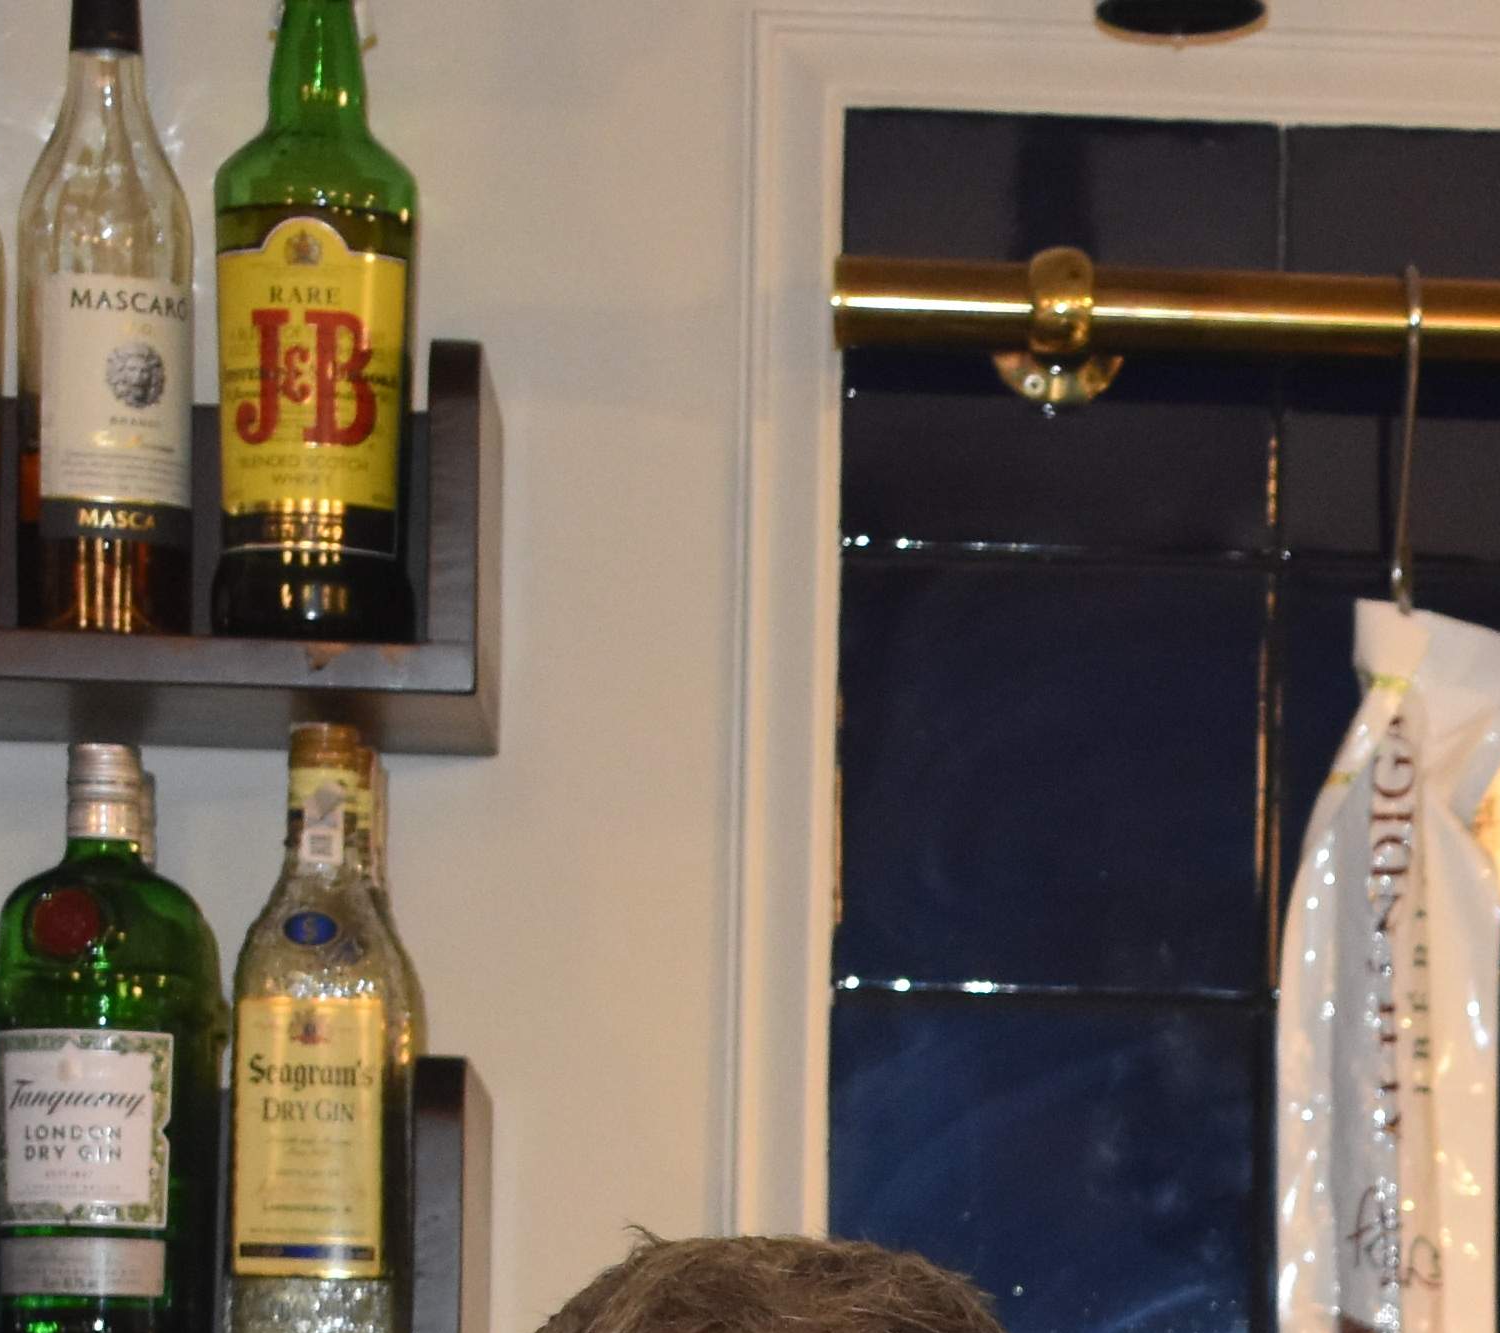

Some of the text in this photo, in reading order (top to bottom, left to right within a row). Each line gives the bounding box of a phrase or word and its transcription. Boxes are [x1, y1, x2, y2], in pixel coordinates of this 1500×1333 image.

[269, 286, 340, 304] RARE
[235, 308, 378, 446] J&B
[249, 1053, 374, 1091] Seagram's
[9, 1078, 147, 1117] Tanqueray
[261, 1097, 356, 1122] DRY GIN
[24, 1124, 122, 1143] LONDON
[25, 1145, 122, 1163] DRY GIN
